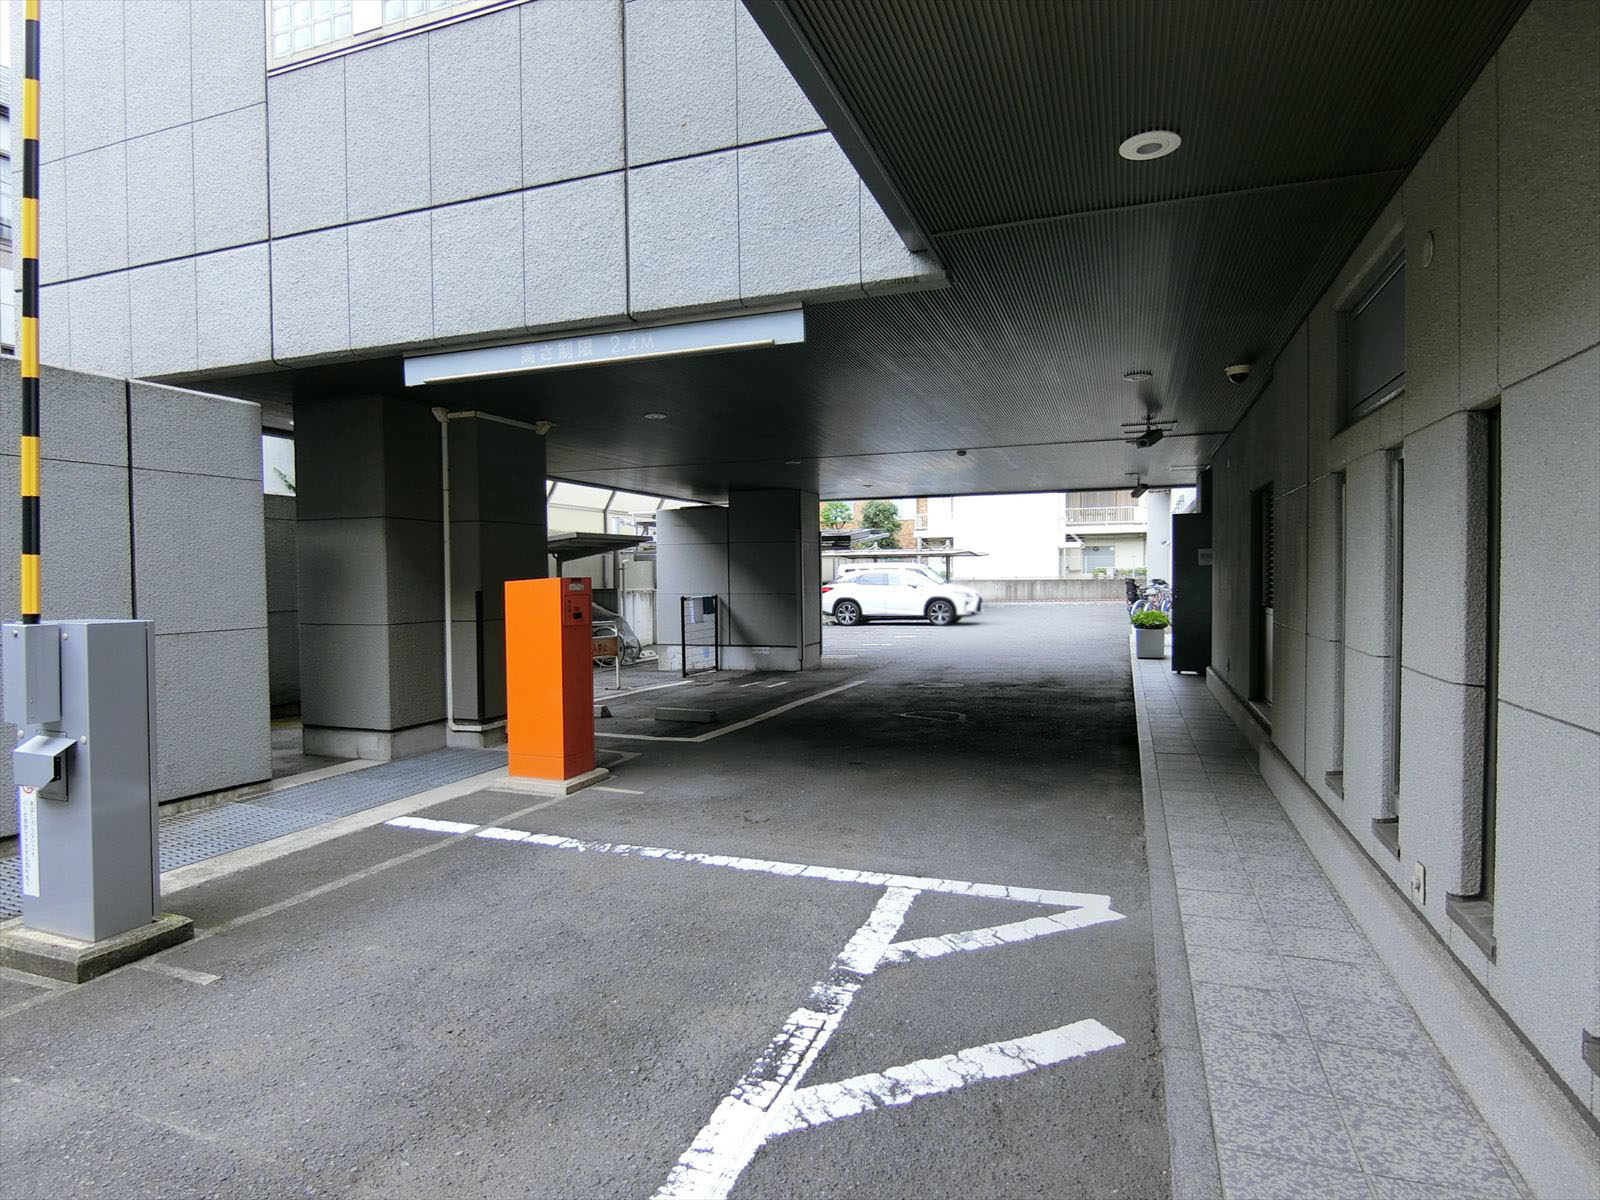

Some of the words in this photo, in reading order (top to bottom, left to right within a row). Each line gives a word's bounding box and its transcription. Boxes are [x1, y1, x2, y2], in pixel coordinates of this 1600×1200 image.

[521, 339, 592, 363] 高さ制限
[611, 335, 654, 353] 2.4M
